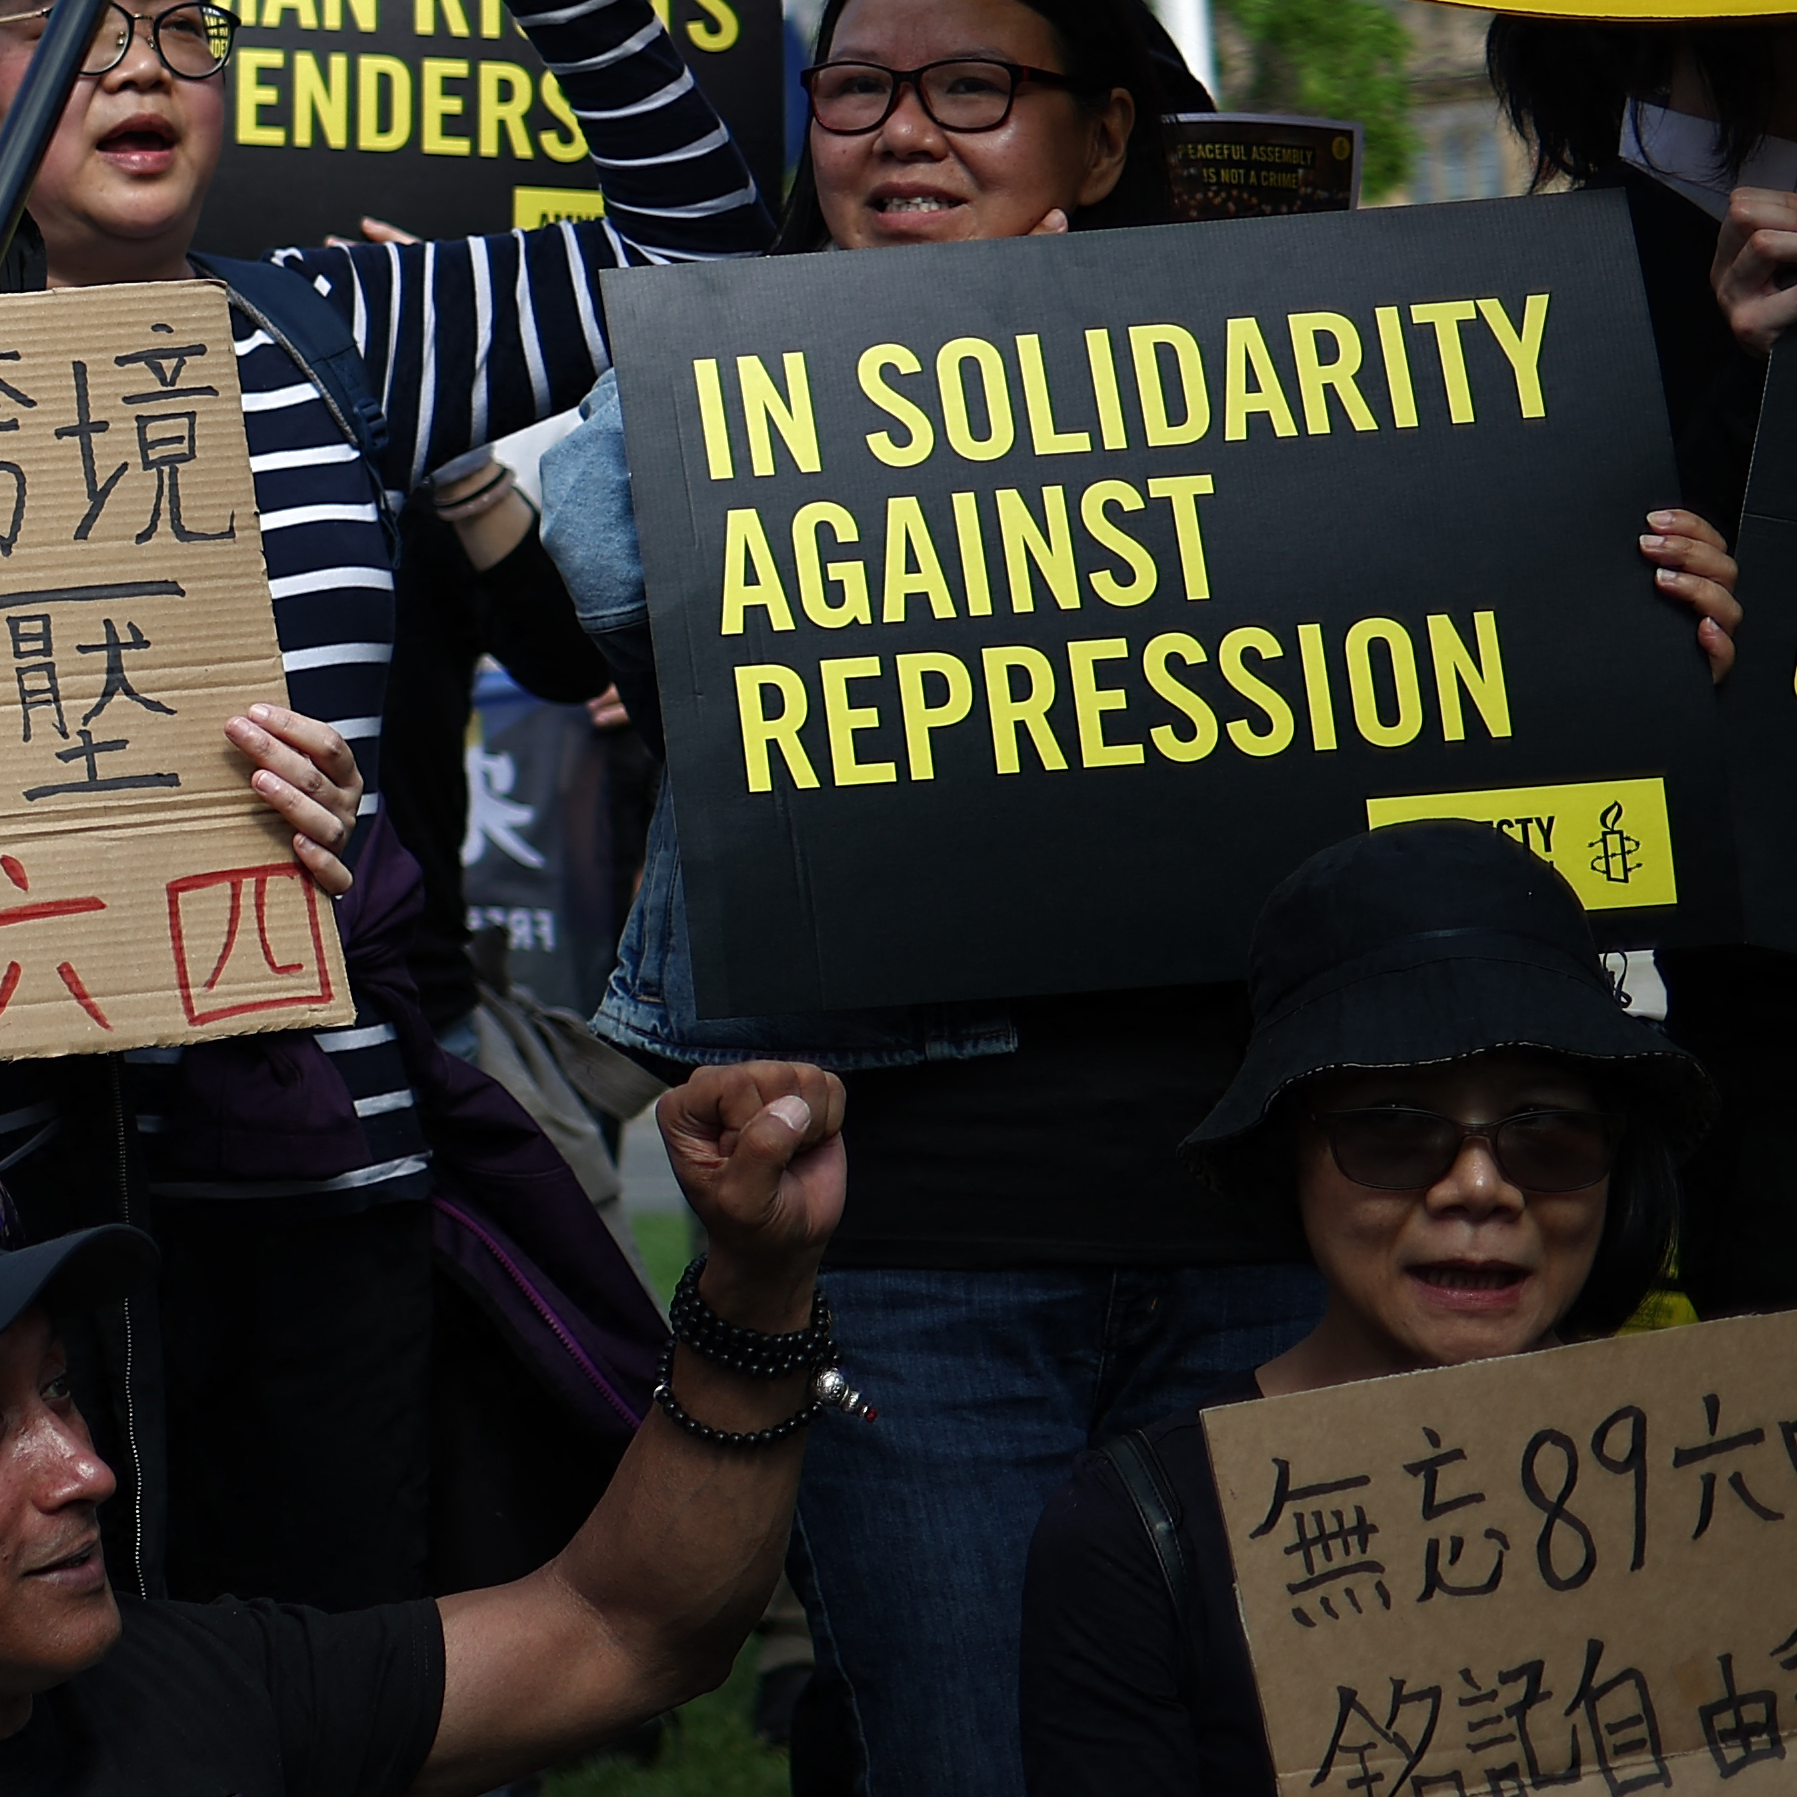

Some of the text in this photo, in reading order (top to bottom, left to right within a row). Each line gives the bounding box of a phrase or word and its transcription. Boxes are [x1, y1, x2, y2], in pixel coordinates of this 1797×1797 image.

[1220, 168, 1246, 184] NOT
[1249, 170, 1257, 186] A
[1261, 171, 1298, 189] CRIME
[1251, 145, 1314, 165] ASSEMBLY
[694, 293, 1551, 481] IN SOLIDARITY
[721, 473, 1214, 636] AGAINST
[733, 610, 1513, 794] REPRESSION
[1250, 1393, 1797, 1627] 無忘89六
